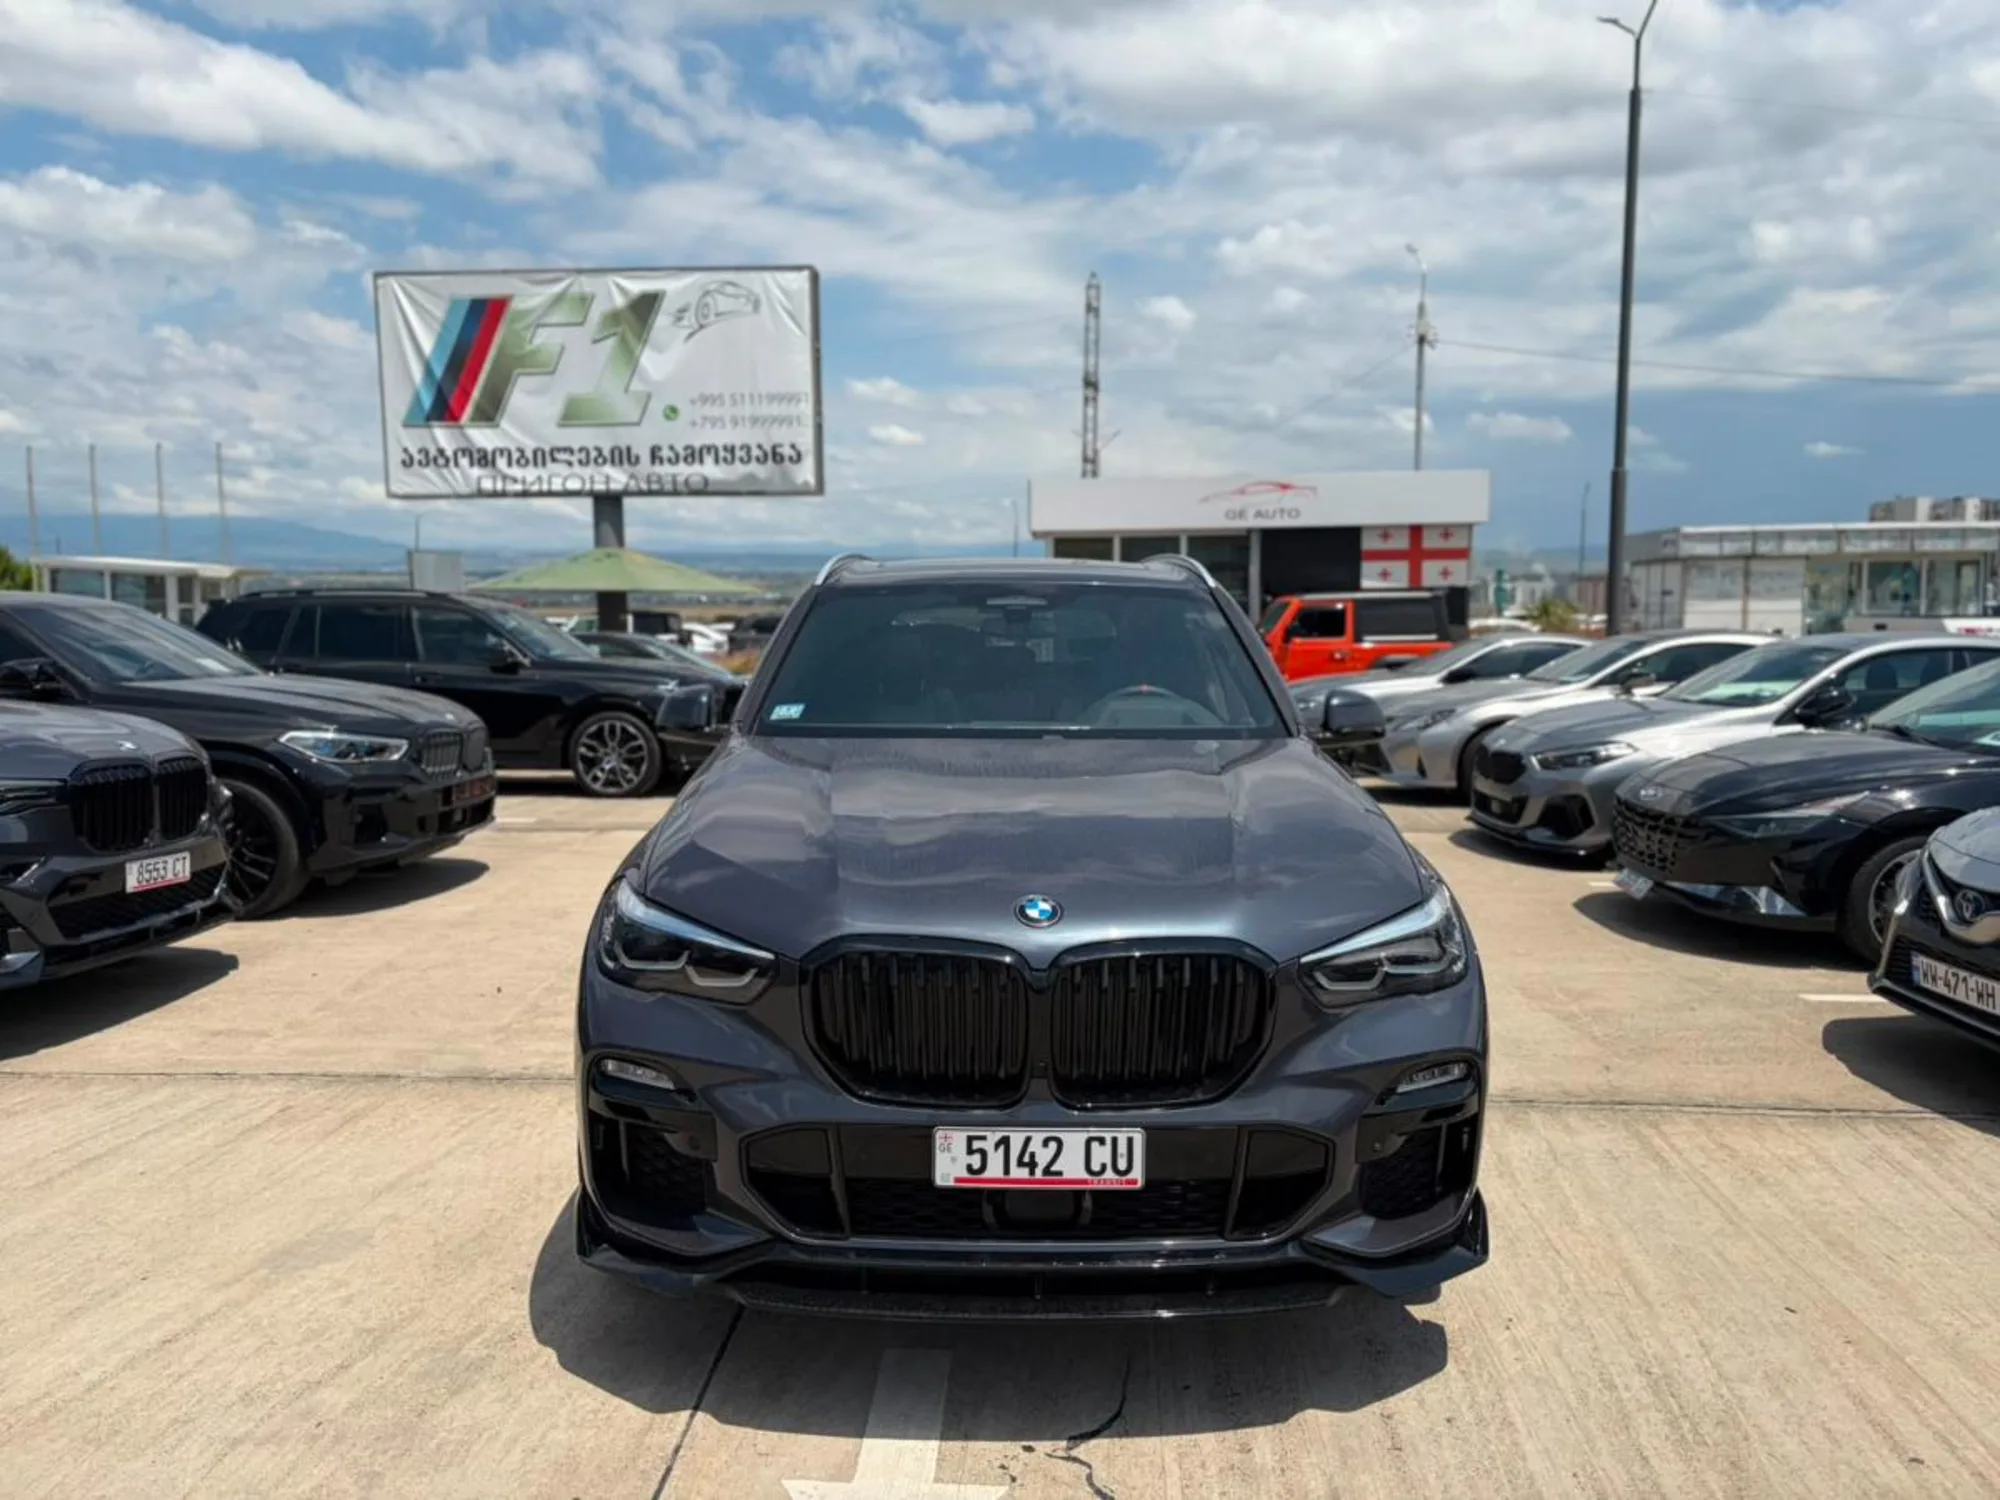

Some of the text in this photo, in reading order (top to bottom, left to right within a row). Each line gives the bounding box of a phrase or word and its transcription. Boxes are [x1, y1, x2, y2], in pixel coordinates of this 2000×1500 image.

[650, 444, 803, 466] ჩამოყვანა
[622, 472, 710, 494] АВТО
[1252, 507, 1302, 520] AUTO
[136, 856, 188, 884] 8553 CT
[965, 1134, 1134, 1177] 5142 CU
